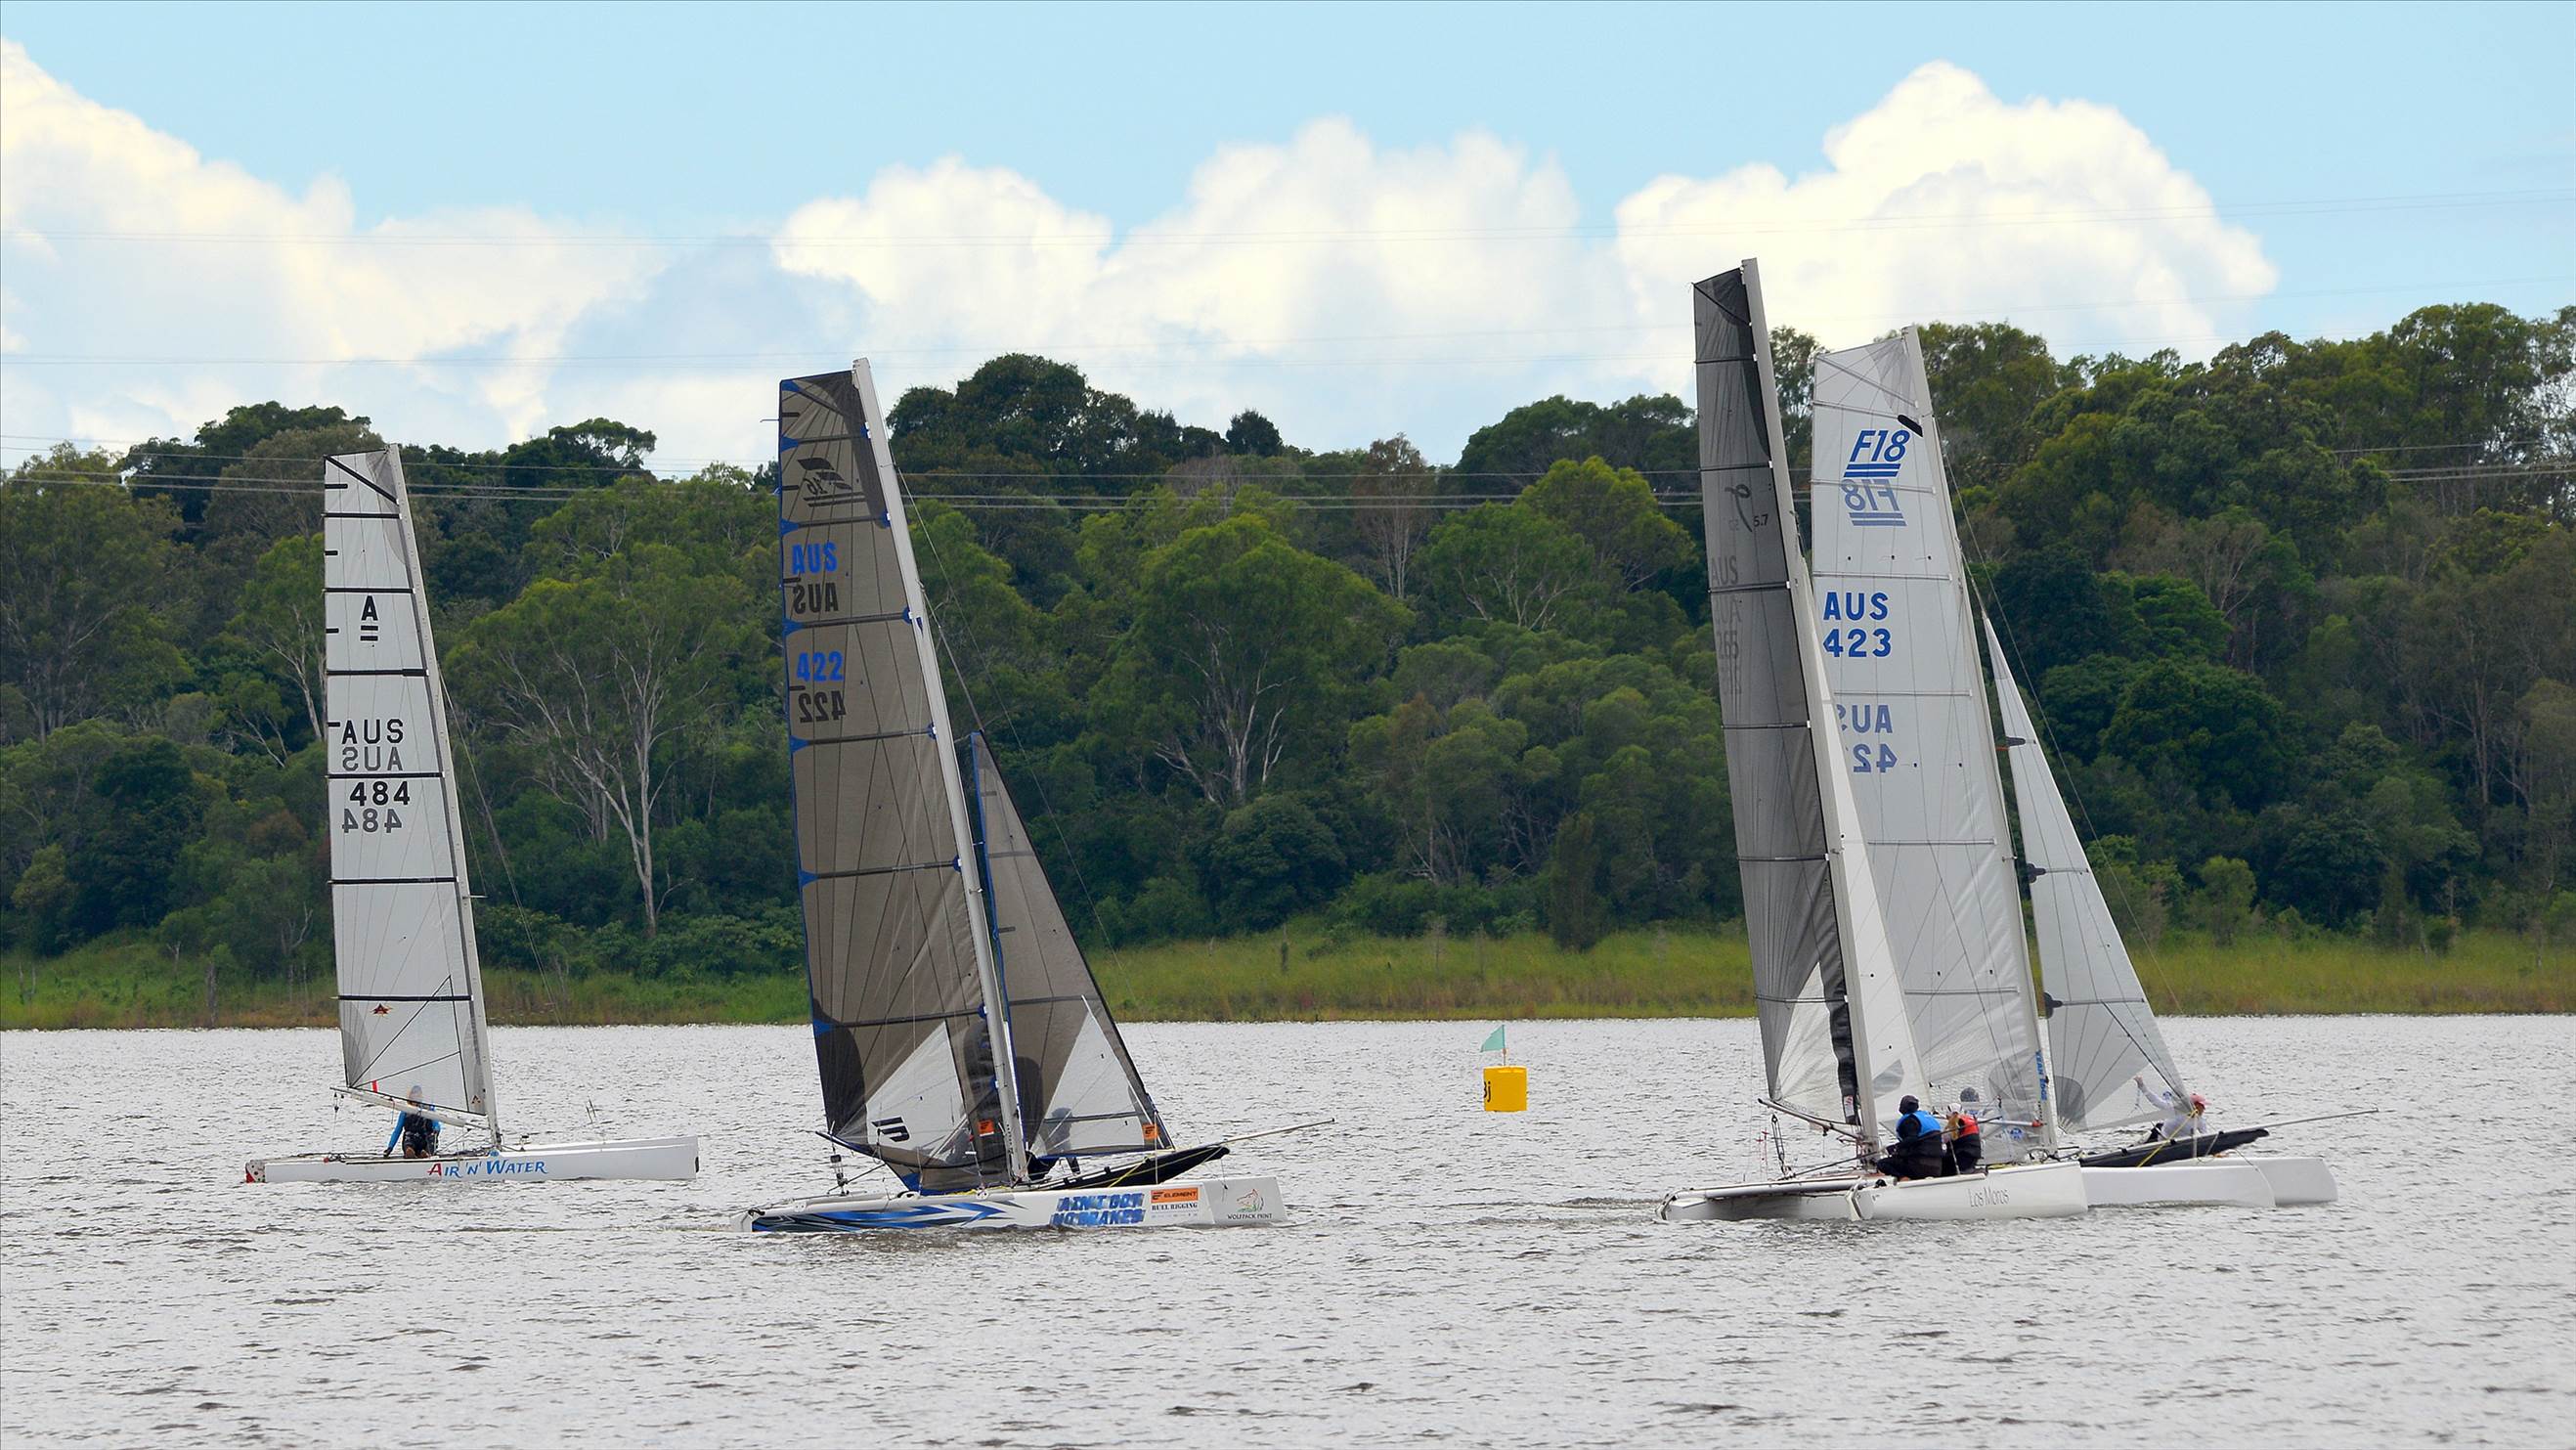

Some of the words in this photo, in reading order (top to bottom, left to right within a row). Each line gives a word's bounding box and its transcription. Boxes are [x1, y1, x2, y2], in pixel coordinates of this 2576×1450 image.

[1849, 429, 1910, 462] F18
[791, 542, 838, 575] AUS
[361, 594, 379, 621] A
[1823, 592, 1889, 621] AUS
[1823, 628, 1892, 658] 423
[796, 650, 846, 682] 422
[342, 719, 404, 745] AUS
[349, 781, 411, 807] 484
